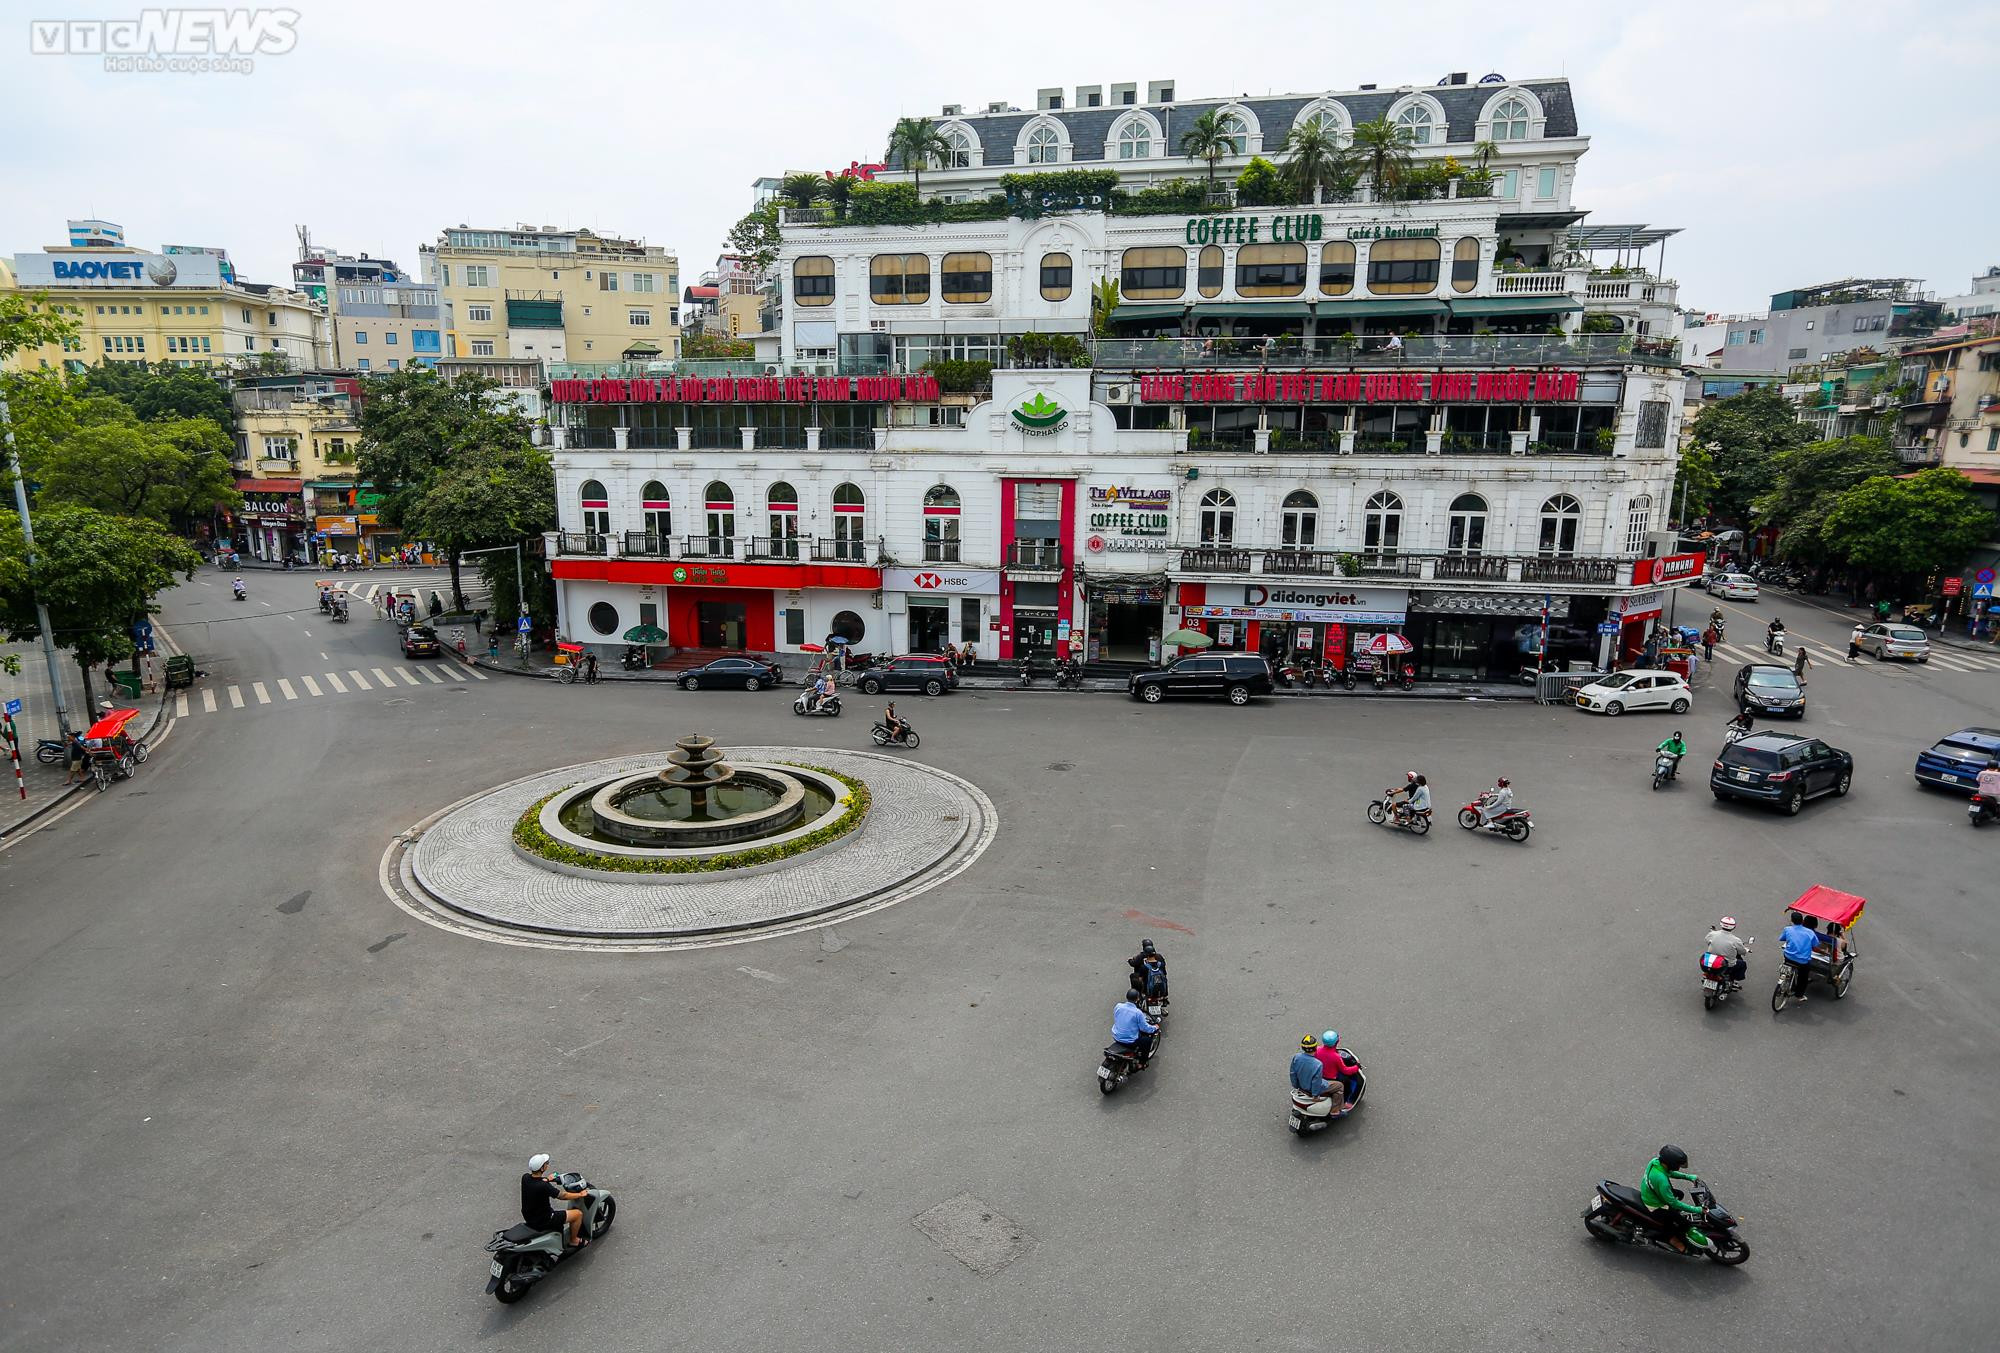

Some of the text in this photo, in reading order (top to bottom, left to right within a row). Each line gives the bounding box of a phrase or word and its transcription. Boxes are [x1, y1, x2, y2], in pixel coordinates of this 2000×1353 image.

[1186, 214, 1322, 245] COFFEE CLUB
[1346, 226, 1372, 239] Café
[1384, 223, 1441, 239] Restaurant
[53, 261, 144, 280] BAOVIET
[817, 377, 849, 401] NAM
[1321, 374, 1361, 401] NAM
[1365, 374, 1423, 404] QUANG
[1430, 374, 1472, 401] VINH
[1010, 421, 1069, 437] PHYTOPHARCO
[1091, 513, 1168, 528] COFFEE CLUB
[944, 578, 968, 586] HSBC
[1187, 618, 1199, 627] 03
